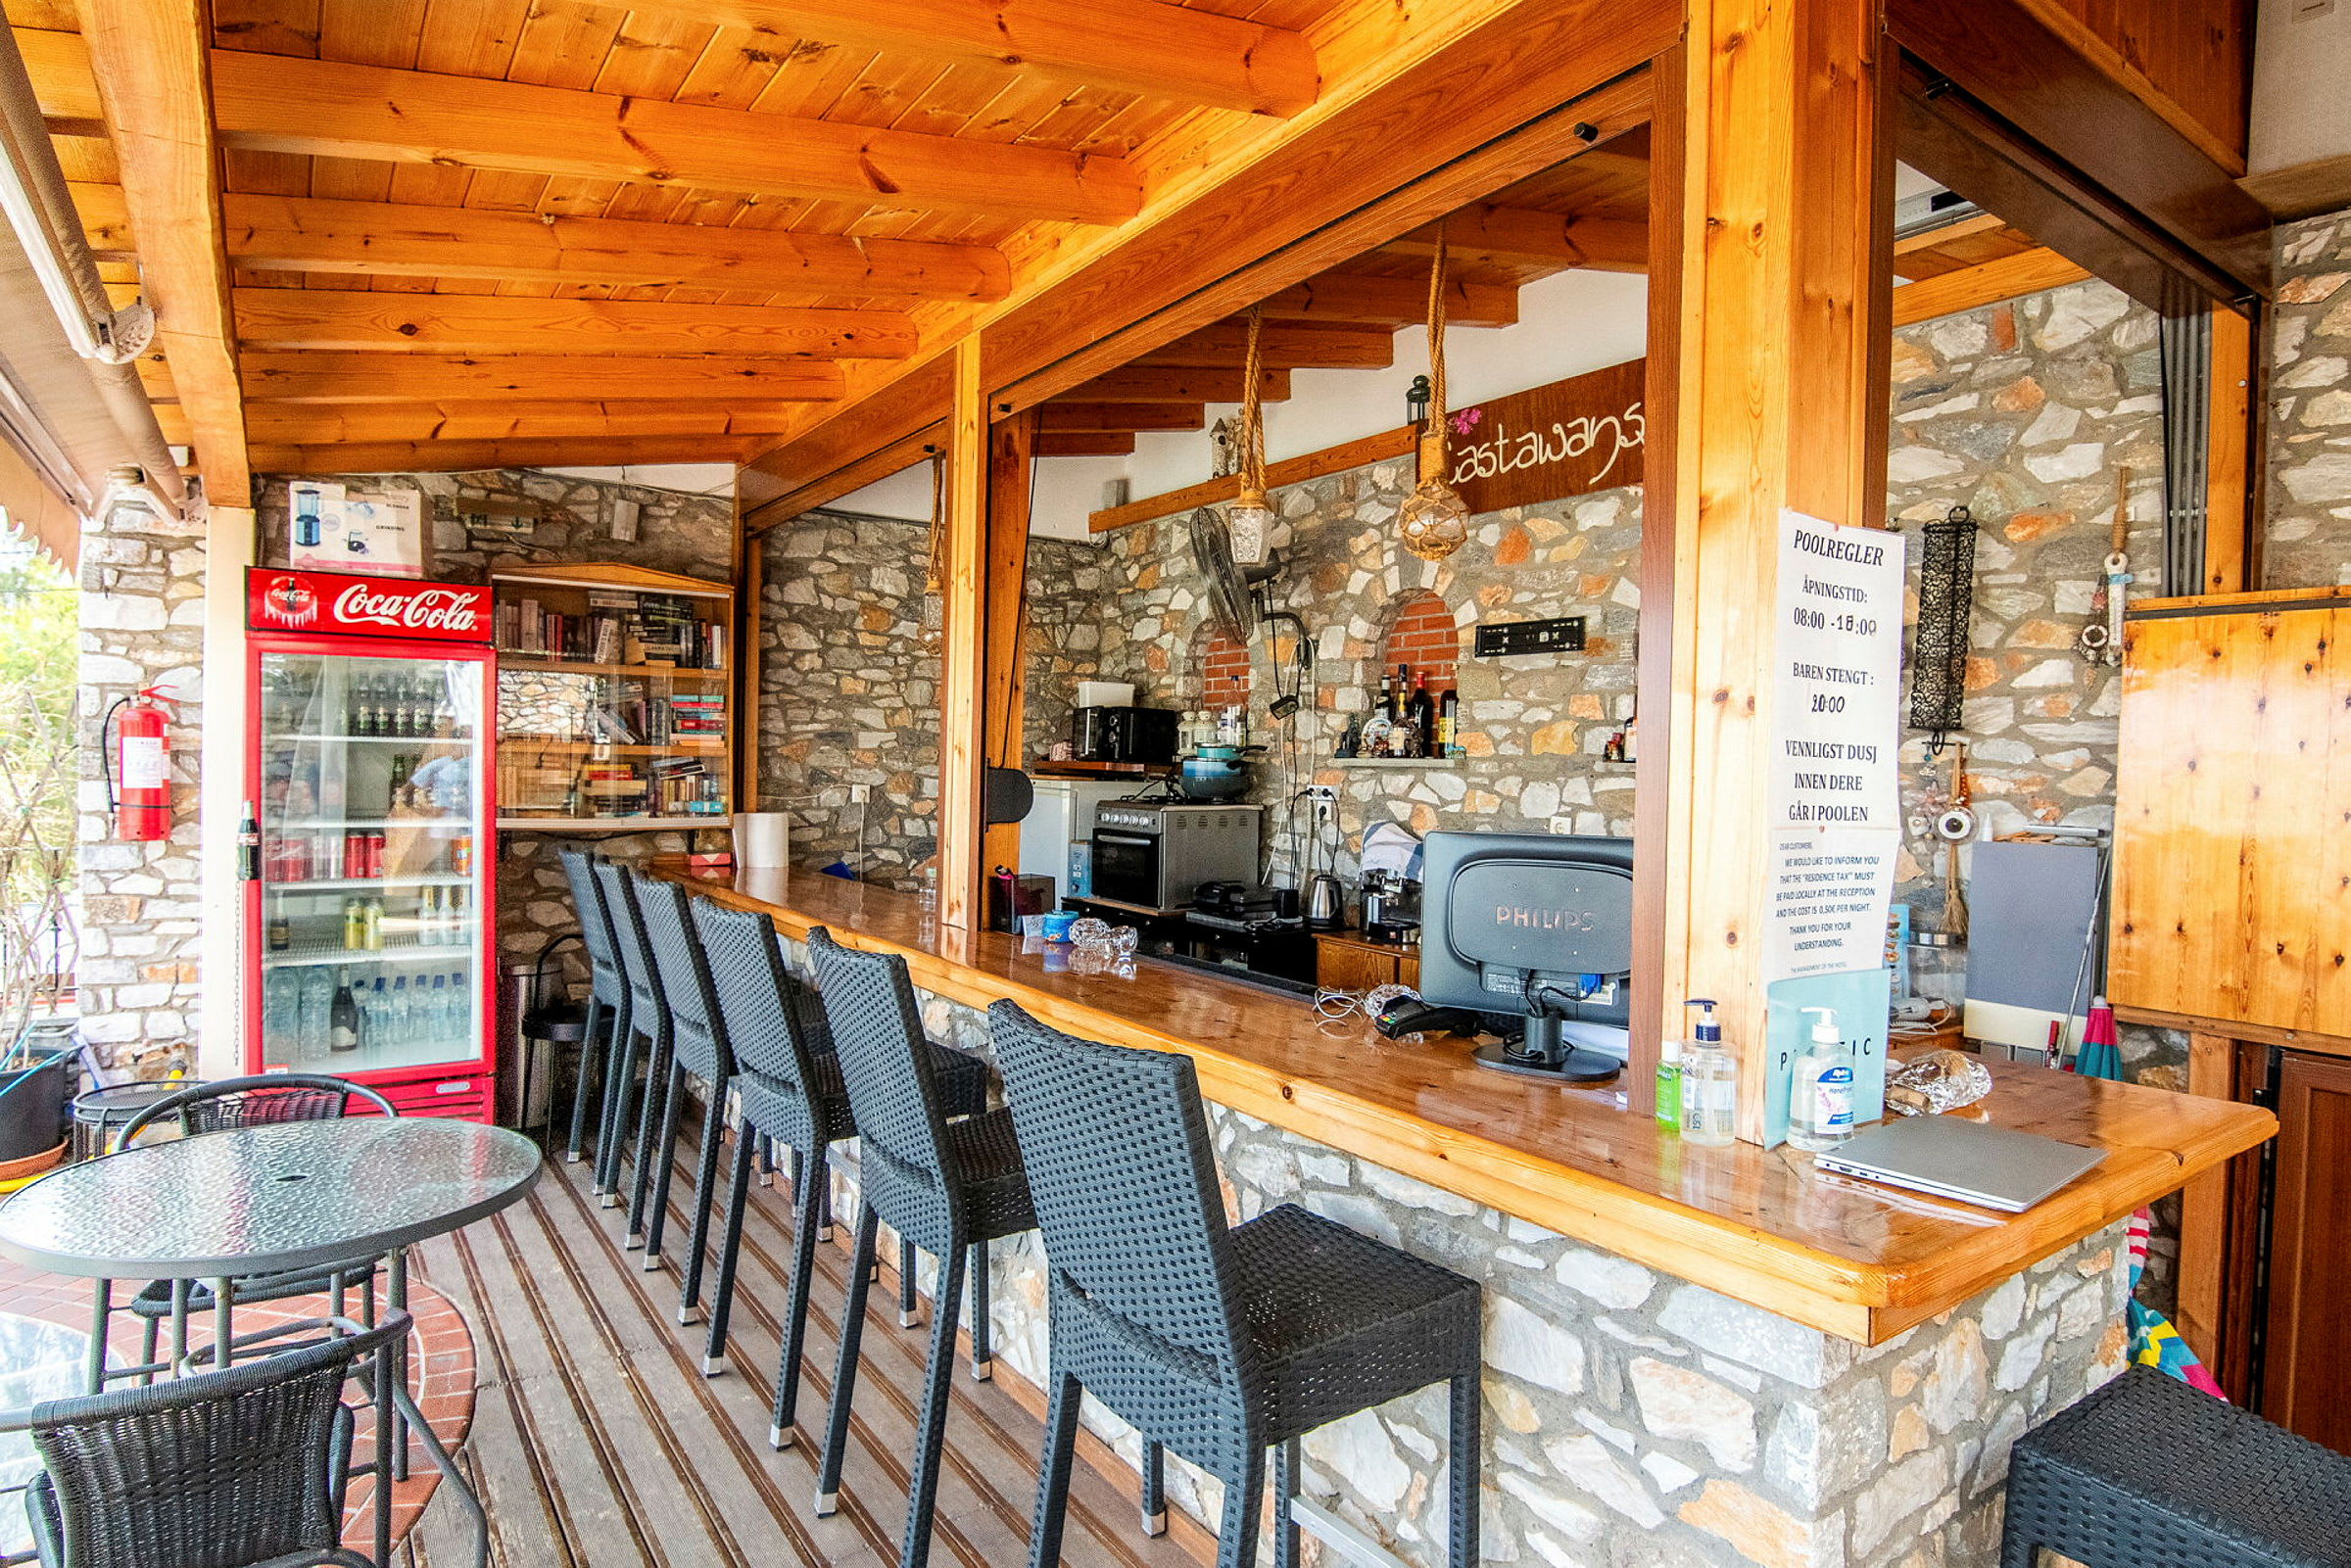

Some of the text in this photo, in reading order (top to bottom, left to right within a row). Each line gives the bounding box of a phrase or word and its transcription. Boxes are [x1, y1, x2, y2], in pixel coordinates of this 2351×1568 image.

[1794, 529, 1884, 566] POOLREGLER
[1802, 574, 1868, 603] ÅPNINGSTID:
[333, 584, 479, 630] Coca-Cola
[1794, 606, 1825, 630] 08:00
[1793, 661, 1824, 680] BAREN
[1785, 739, 1877, 764] VENNLIGST DUSJ
[1794, 773, 1863, 790] INNEN DERE
[1789, 799, 1868, 821] GÅR I POOLEN
[1793, 857, 1810, 867] WOULD
[1811, 857, 1823, 866] LIKE
[1824, 856, 1834, 865] TO
[1834, 856, 1862, 865] INFORM
[1864, 855, 1880, 865] YOU
[1854, 872, 1875, 880] MUST
[1783, 891, 1795, 900] PAID
[1795, 889, 1817, 899] LOCALLY
[1817, 888, 1825, 898] AT
[1827, 888, 1838, 897] THE
[1840, 886, 1876, 897] RECEPTION
[1496, 905, 1597, 931] PHILIPS
[1776, 909, 1787, 918] AND
[1788, 907, 1797, 917] THE
[1798, 906, 1811, 916] COST
[1811, 905, 1817, 915] IS
[1837, 903, 1848, 912] PER
[1789, 922, 1851, 935] THANK YOU FOR YOUR
